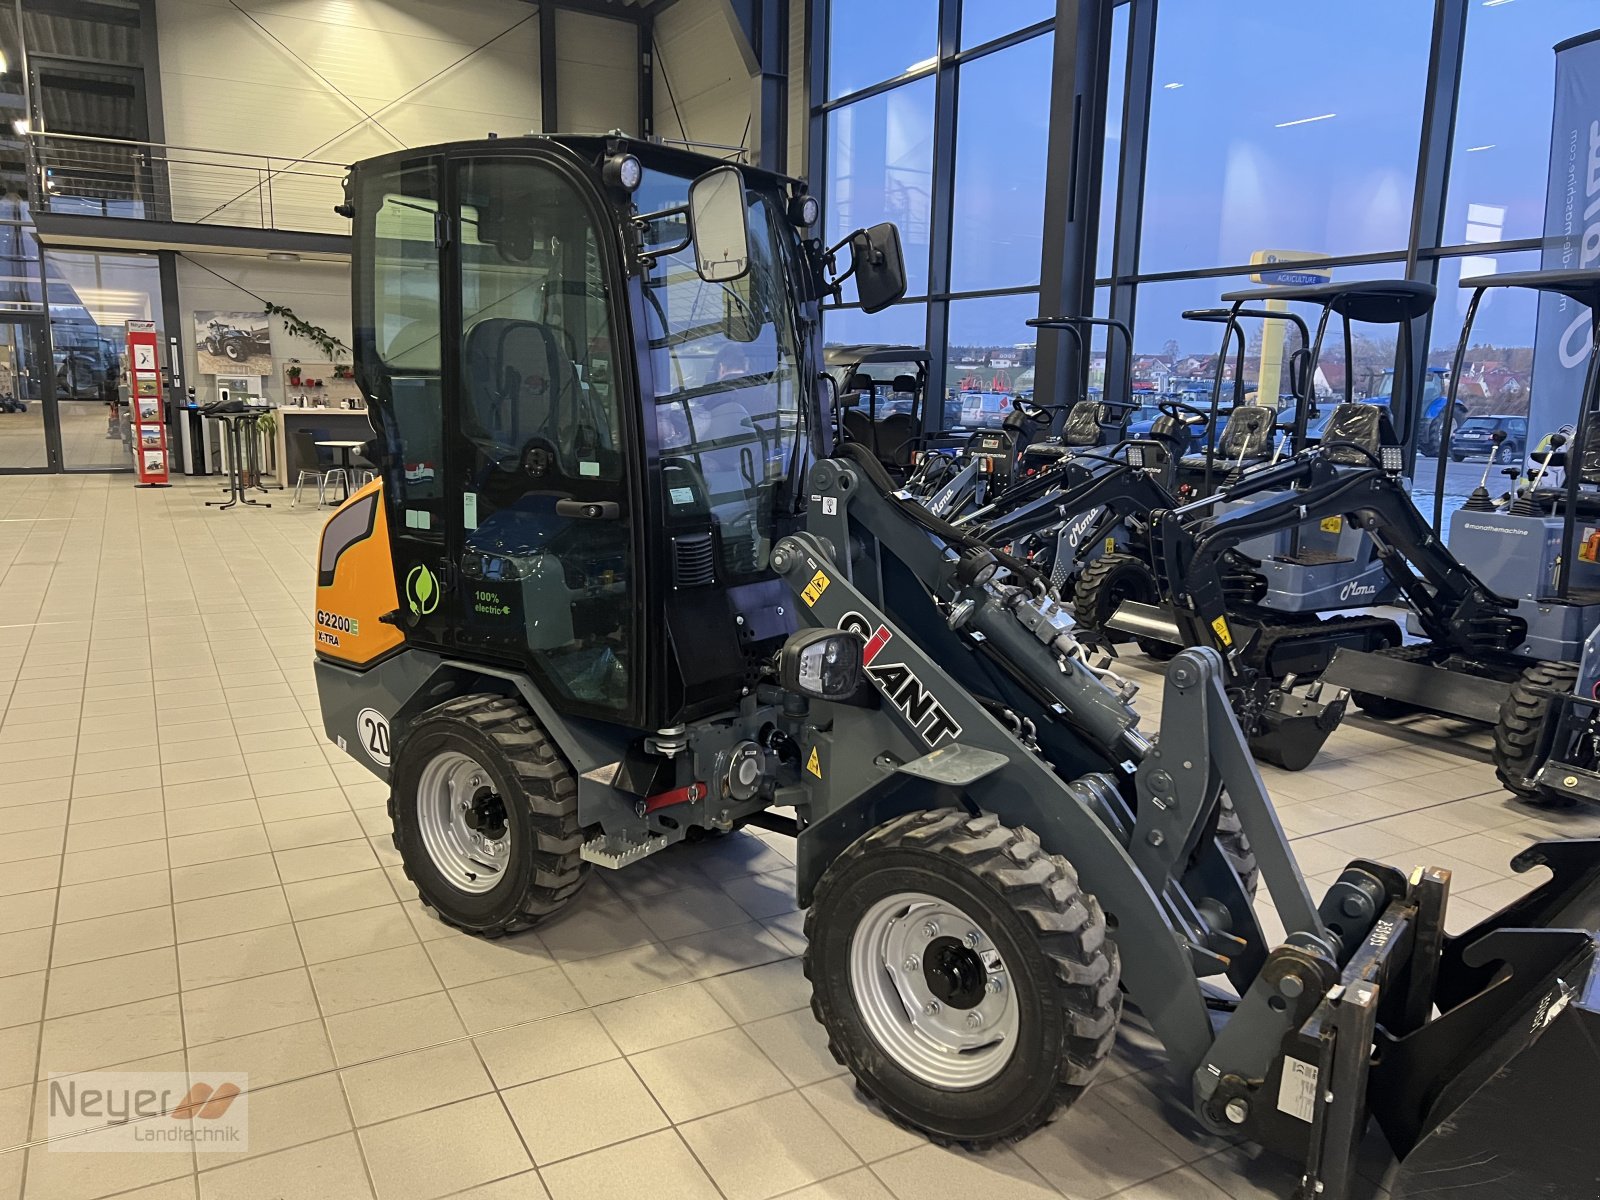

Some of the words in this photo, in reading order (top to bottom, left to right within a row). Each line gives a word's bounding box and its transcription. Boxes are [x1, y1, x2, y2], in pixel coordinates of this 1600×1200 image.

[1277, 273, 1317, 284] AGRICULTURE
[1070, 508, 1099, 547] Mona
[1464, 523, 1529, 536] @monathemachine
[475, 591, 500, 604] 100%
[1340, 581, 1376, 601] Mona
[475, 603, 501, 615] electric
[318, 631, 340, 646] X-TRA
[365, 717, 390, 757] 20
